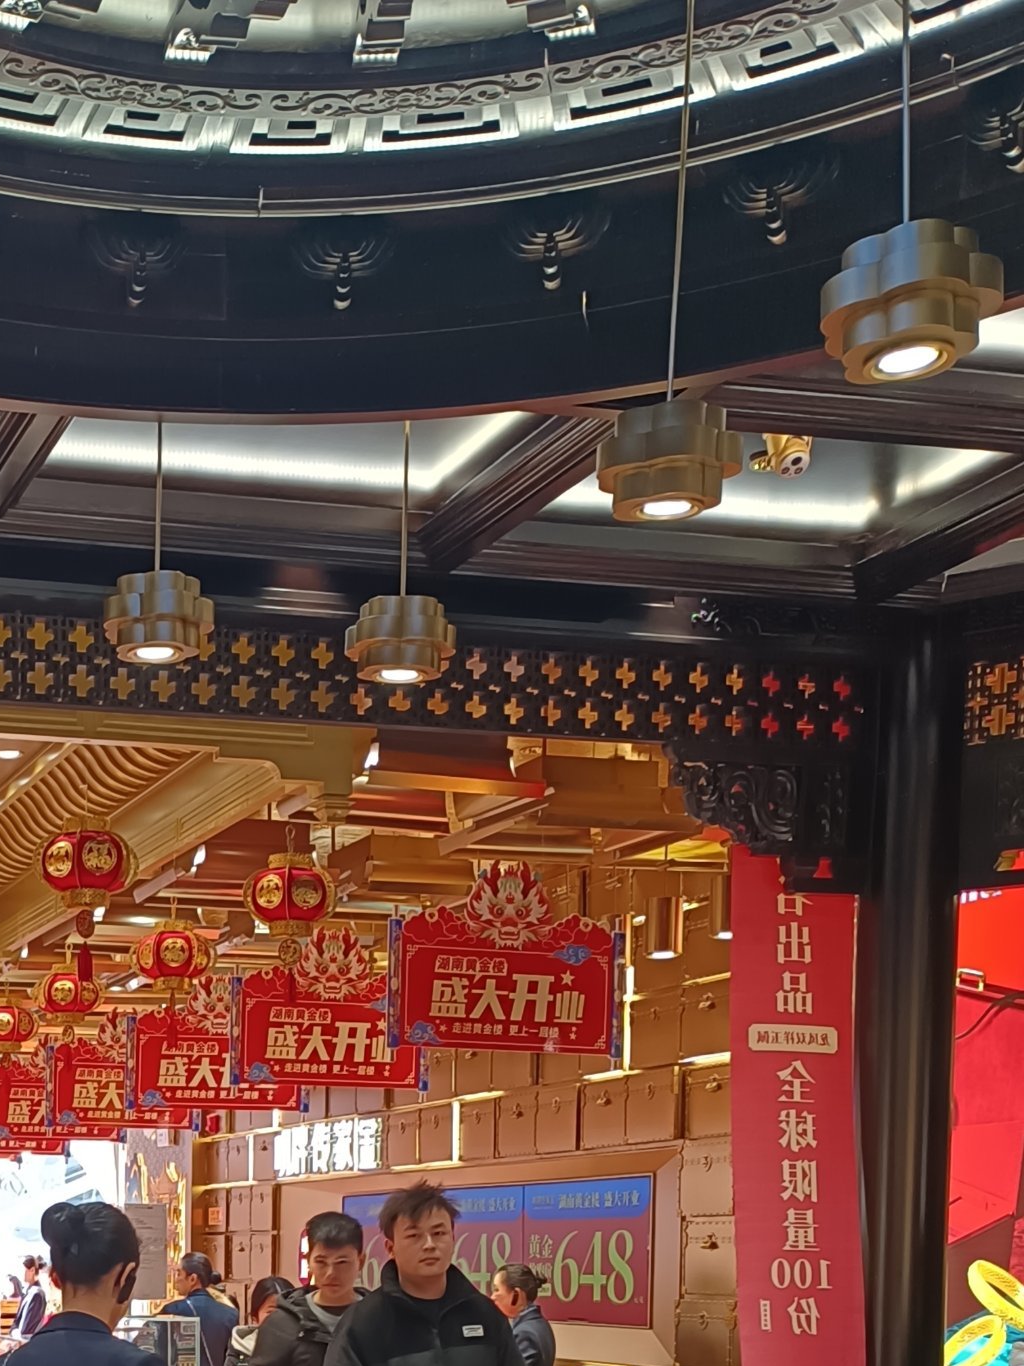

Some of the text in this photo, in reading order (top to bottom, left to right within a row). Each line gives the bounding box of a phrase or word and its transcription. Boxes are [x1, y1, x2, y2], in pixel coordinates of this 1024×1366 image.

[436, 957, 507, 975] 湖南黄金楼
[429, 974, 585, 1024] 盛大开业
[272, 1007, 330, 1023] 湖南黄金楼
[452, 1022, 503, 1036] 走进黄金楼
[528, 1234, 553, 1259] 黄金
[553, 1229, 635, 1304] 648
